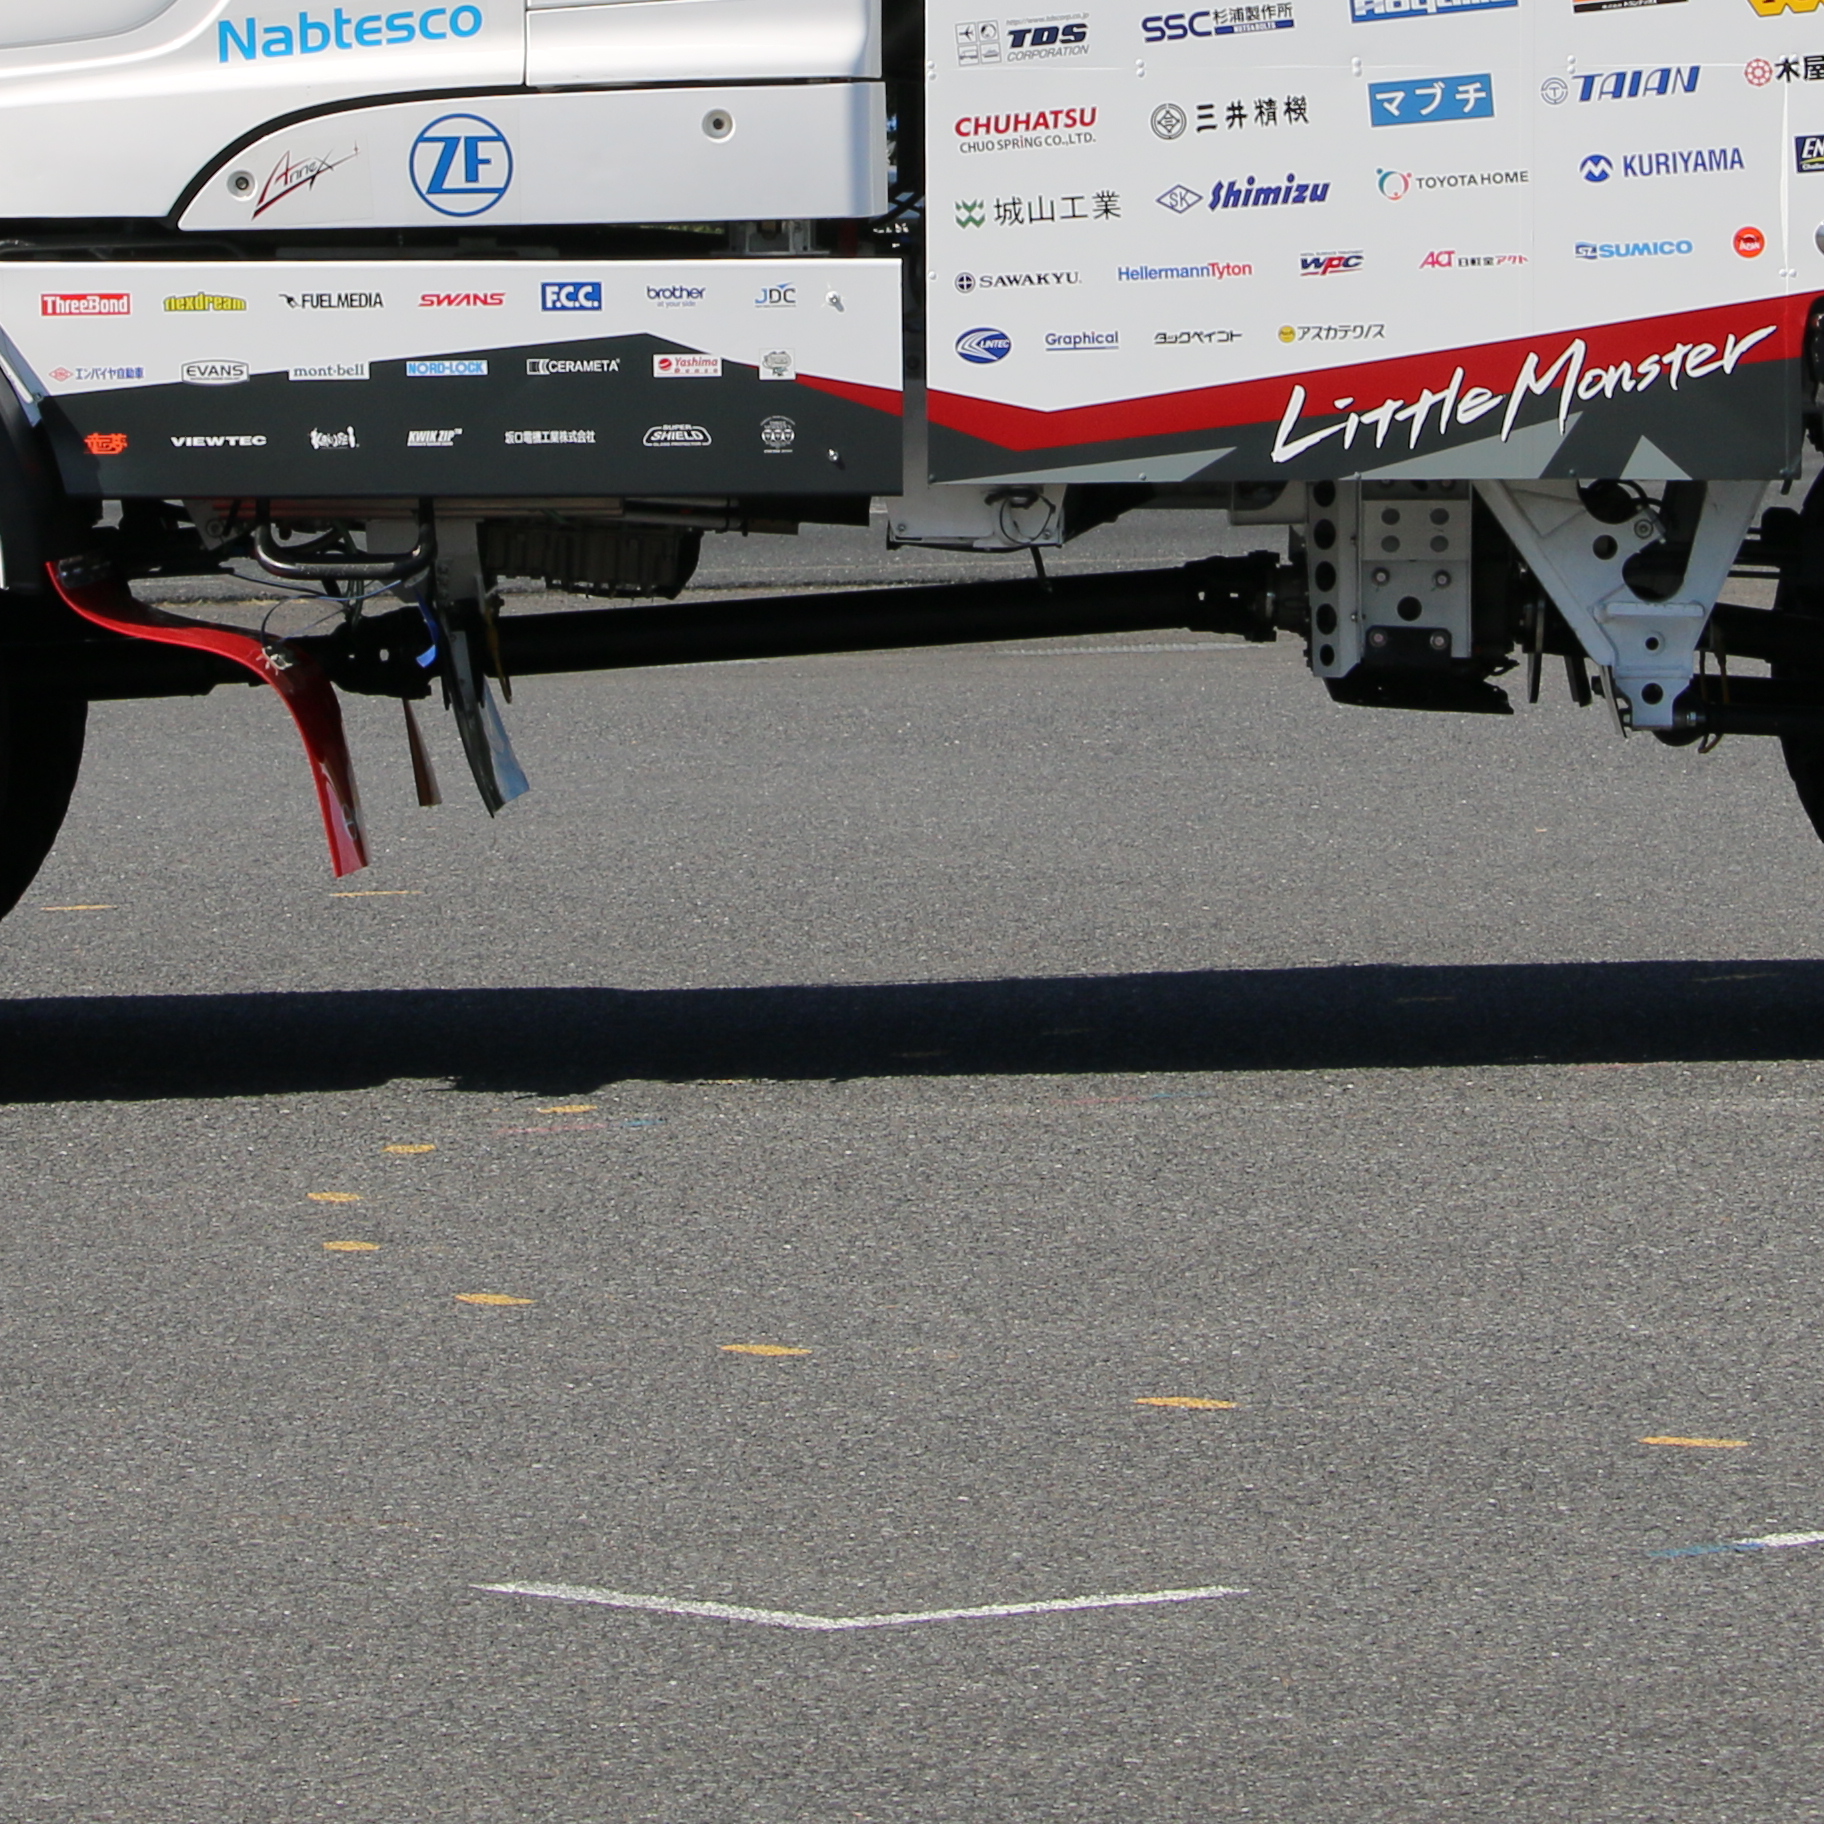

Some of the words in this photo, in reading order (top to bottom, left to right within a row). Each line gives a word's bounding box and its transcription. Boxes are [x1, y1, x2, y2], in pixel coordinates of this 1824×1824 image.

[1213, 2, 1293, 24] 杉浦製作所
[218, 5, 483, 62] Nabtesco
[1142, 10, 1211, 42] SSC
[1007, 23, 1089, 49] TDS
[1007, 44, 1089, 62] CORPORATION
[1573, 65, 1700, 101] TAIAN
[1376, 81, 1487, 116] マブチ
[955, 107, 1097, 138] CHUHATSU
[1196, 95, 1309, 133] 三井精機
[960, 140, 994, 154] CHUO
[418, 136, 502, 194] ZF
[1623, 147, 1745, 177] KURIYAMA
[1416, 175, 1477, 189] TOYOTA
[1481, 171, 1528, 185] HOME
[1209, 173, 1331, 211] Shimizu
[994, 190, 1122, 226] 城山工業
[1599, 240, 1692, 257] SUMICO
[1118, 263, 1252, 282] HellermannTyton
[302, 293, 384, 309] FUELMEDIA
[418, 293, 506, 306] SWANS
[545, 287, 599, 308] F.C.C.
[647, 286, 706, 299] brother
[755, 288, 796, 304] JDC
[43, 296, 127, 313] ThreeBond
[1045, 331, 1119, 348] Graphical
[1154, 330, 1242, 344] タックペイント
[1296, 324, 1386, 341] アスカテクノス
[981, 338, 1010, 348] LINTEC
[186, 365, 243, 376] EVANS
[408, 362, 484, 374] NORD-LOCK
[675, 358, 718, 367] Yashima
[75, 367, 144, 380] エンパイヤ自動車
[1271, 367, 1506, 463] Little
[1500, 325, 1777, 442] Monster
[171, 436, 267, 447] VIEWTEC
[651, 430, 703, 440] SHIELD
